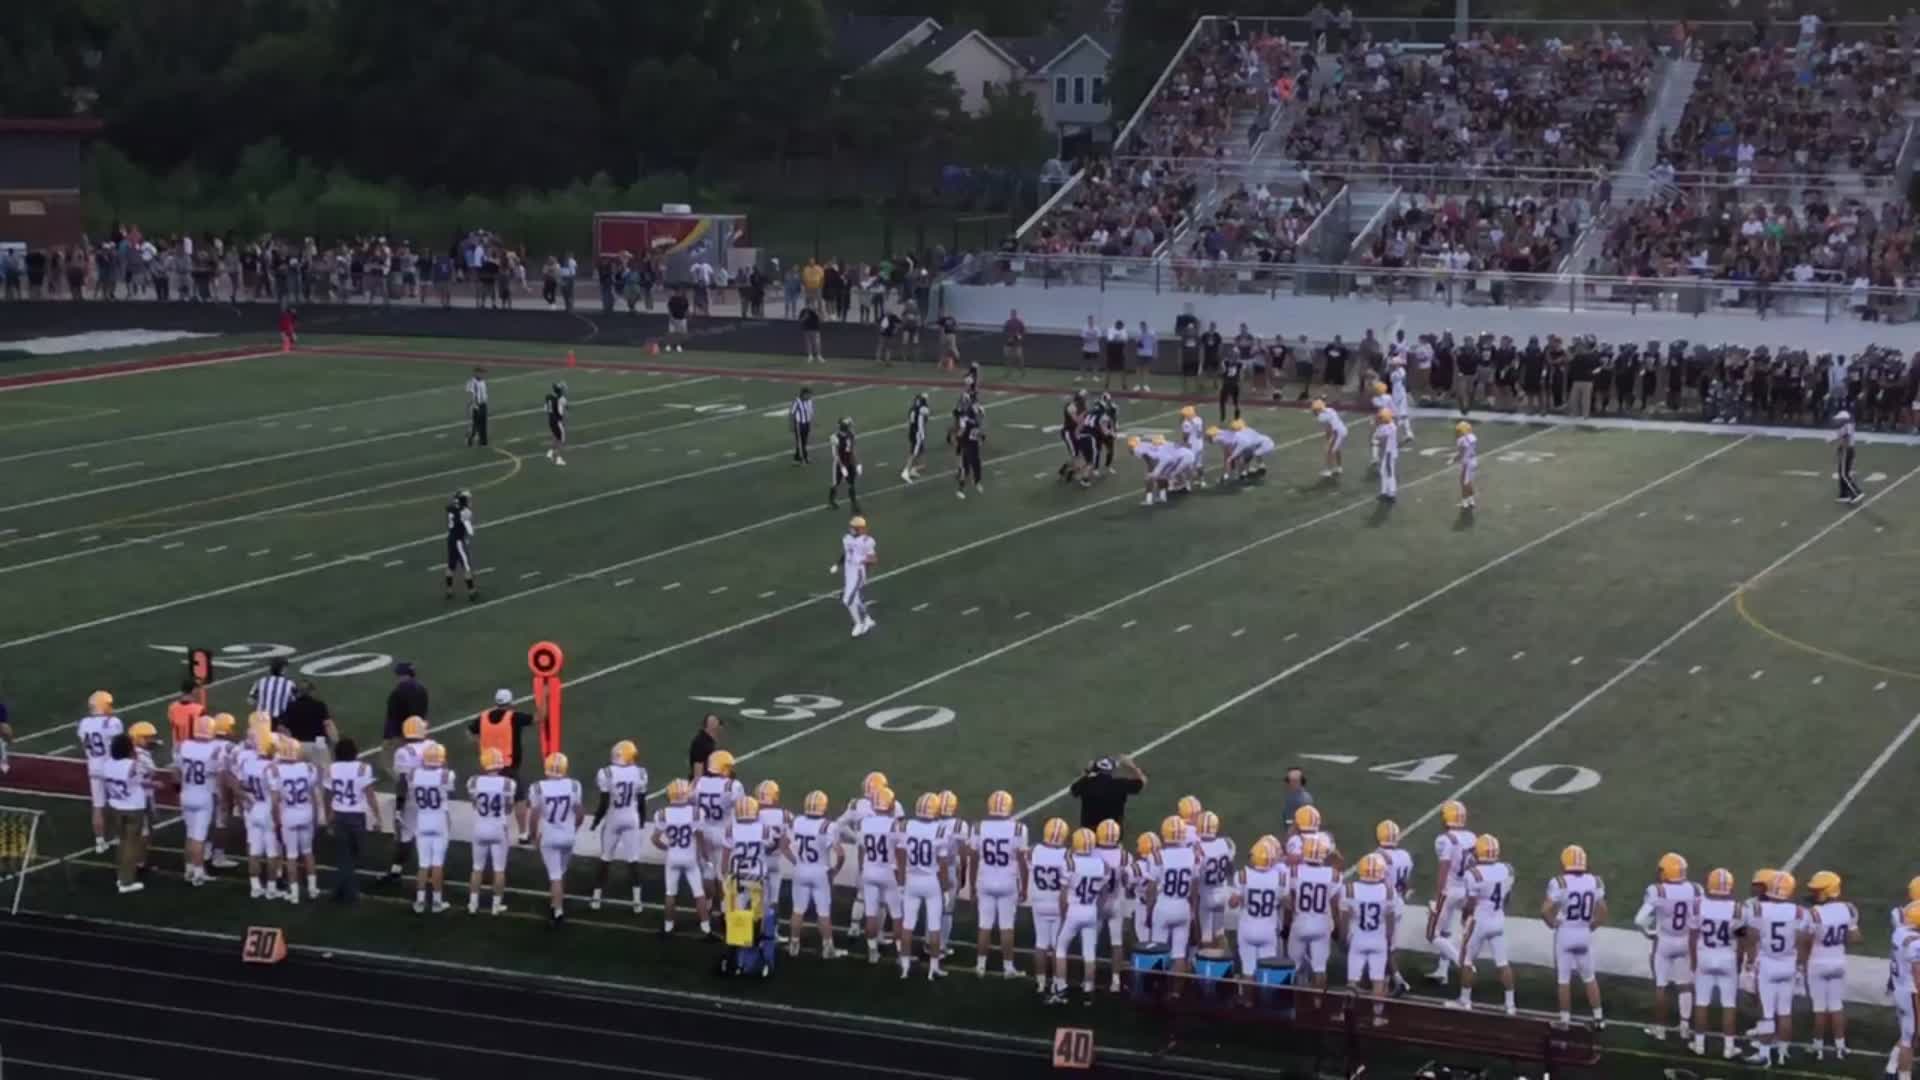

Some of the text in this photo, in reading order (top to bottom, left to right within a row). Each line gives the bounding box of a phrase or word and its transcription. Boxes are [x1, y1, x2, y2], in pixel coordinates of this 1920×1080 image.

[740, 694, 956, 731] 30
[183, 759, 206, 785] 78
[1368, 754, 1600, 794] 40
[283, 778, 309, 806] 32
[332, 779, 356, 806] 64
[477, 792, 502, 817] 34
[699, 793, 724, 820] 55
[545, 797, 571, 824] 77
[735, 842, 760, 867] 27
[795, 835, 819, 862] 75
[864, 834, 888, 863] 84
[907, 837, 932, 866] 30
[983, 838, 1010, 866] 65
[1034, 866, 1061, 891] 63
[1075, 876, 1103, 905] 45
[1163, 868, 1192, 898] 86
[1247, 889, 1275, 917] 58
[1299, 882, 1328, 913] 60
[1490, 882, 1502, 911] 4
[1566, 891, 1595, 921] 20
[1359, 902, 1381, 931] 13
[1672, 901, 1688, 931] 8
[247, 929, 276, 958] 30
[1702, 919, 1731, 948] 24
[1770, 921, 1786, 952] 5
[1057, 1031, 1090, 1064] 40
